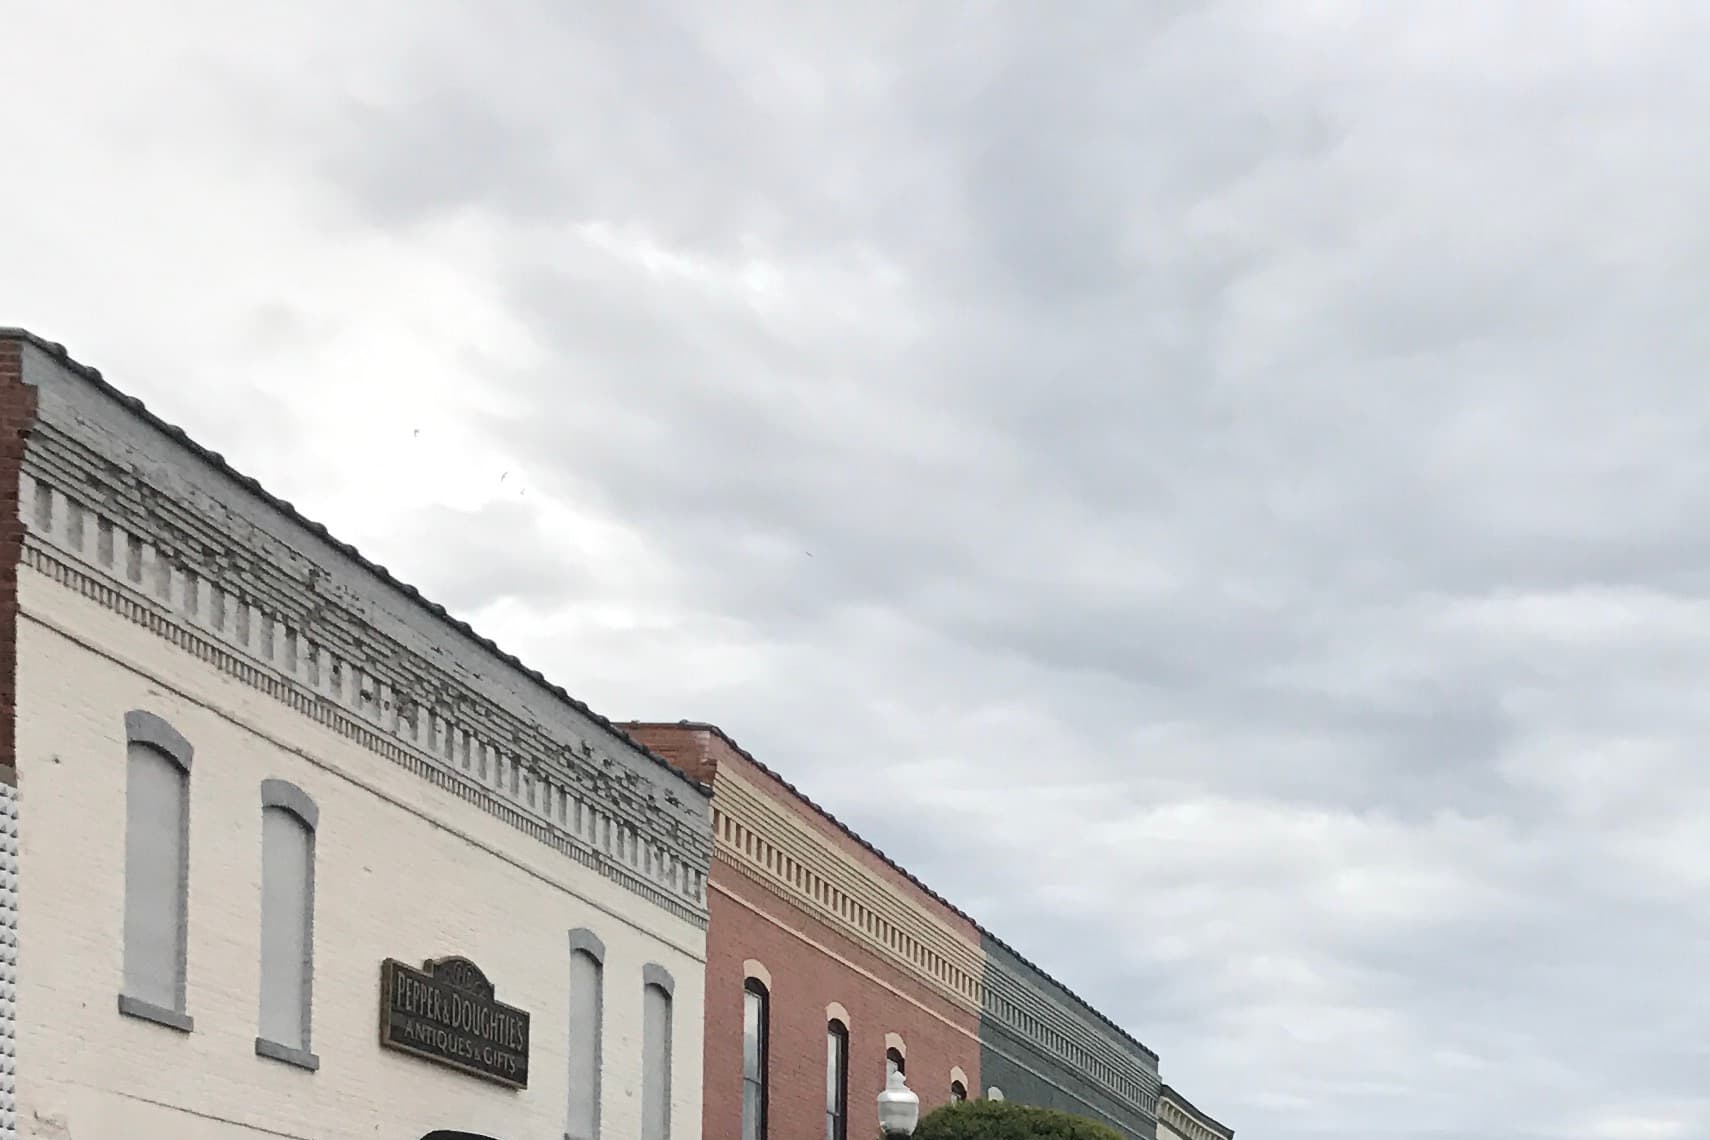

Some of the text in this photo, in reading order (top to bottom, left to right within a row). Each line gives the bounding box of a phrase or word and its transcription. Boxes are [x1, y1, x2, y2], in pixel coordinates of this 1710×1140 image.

[398, 971, 441, 1021] PEPPER
[442, 1000, 451, 1025] &
[404, 1020, 472, 1058] ANTIQUES
[483, 1047, 516, 1073] GIFTS
